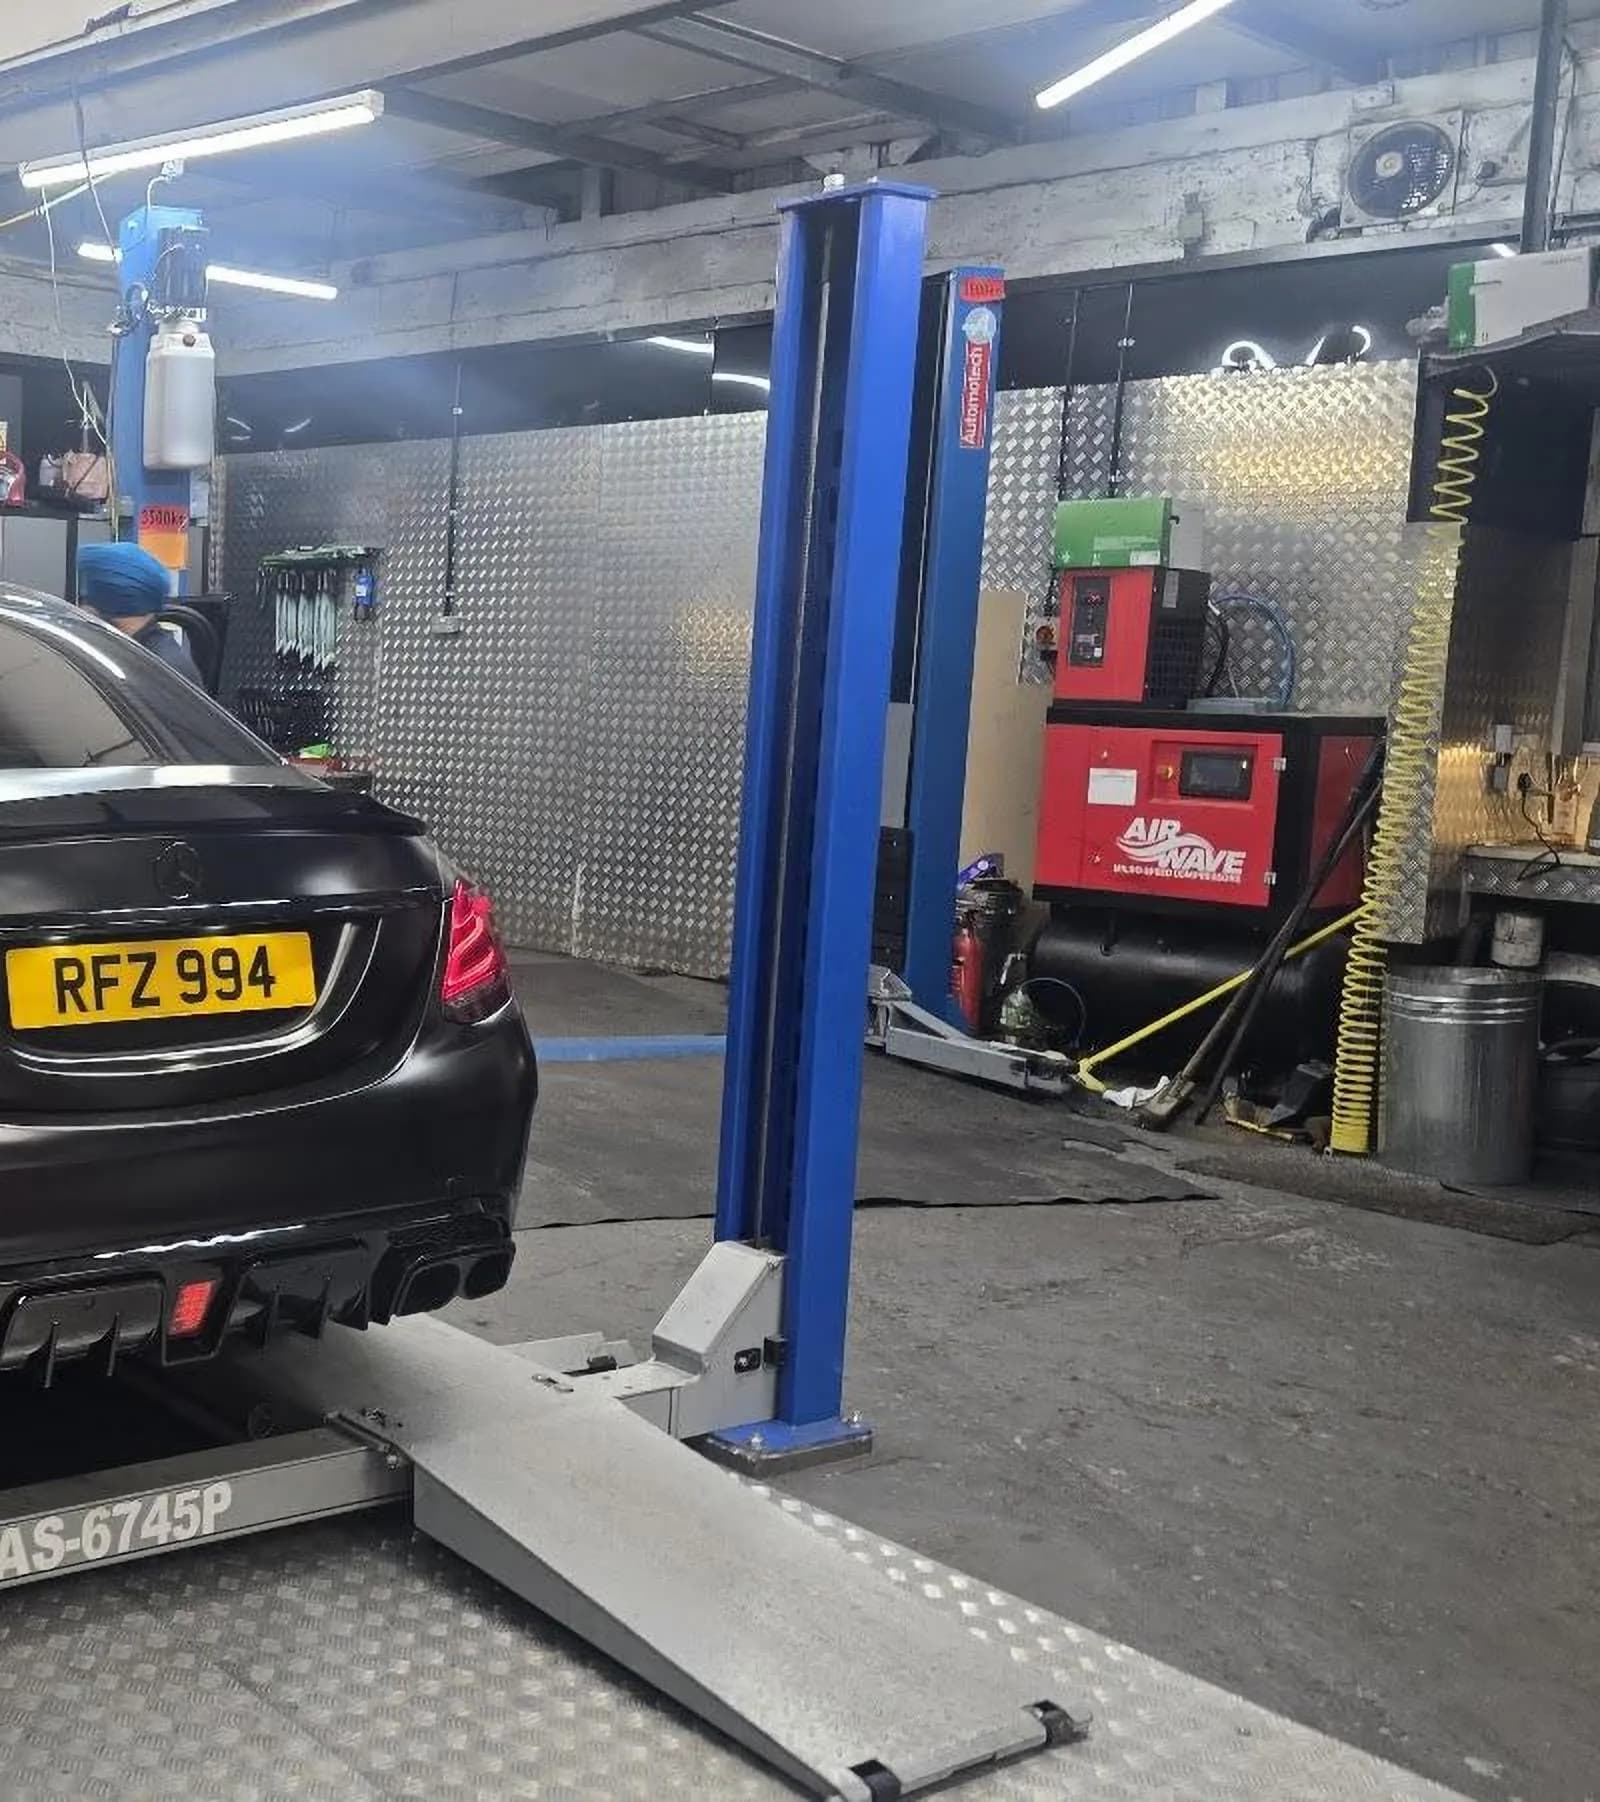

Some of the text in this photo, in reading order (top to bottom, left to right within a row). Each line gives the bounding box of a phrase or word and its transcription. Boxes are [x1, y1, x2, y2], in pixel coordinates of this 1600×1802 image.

[1123, 816, 1182, 842] AIR
[1157, 847, 1248, 878] WAVE
[52, 944, 277, 1015] RFZ 994
